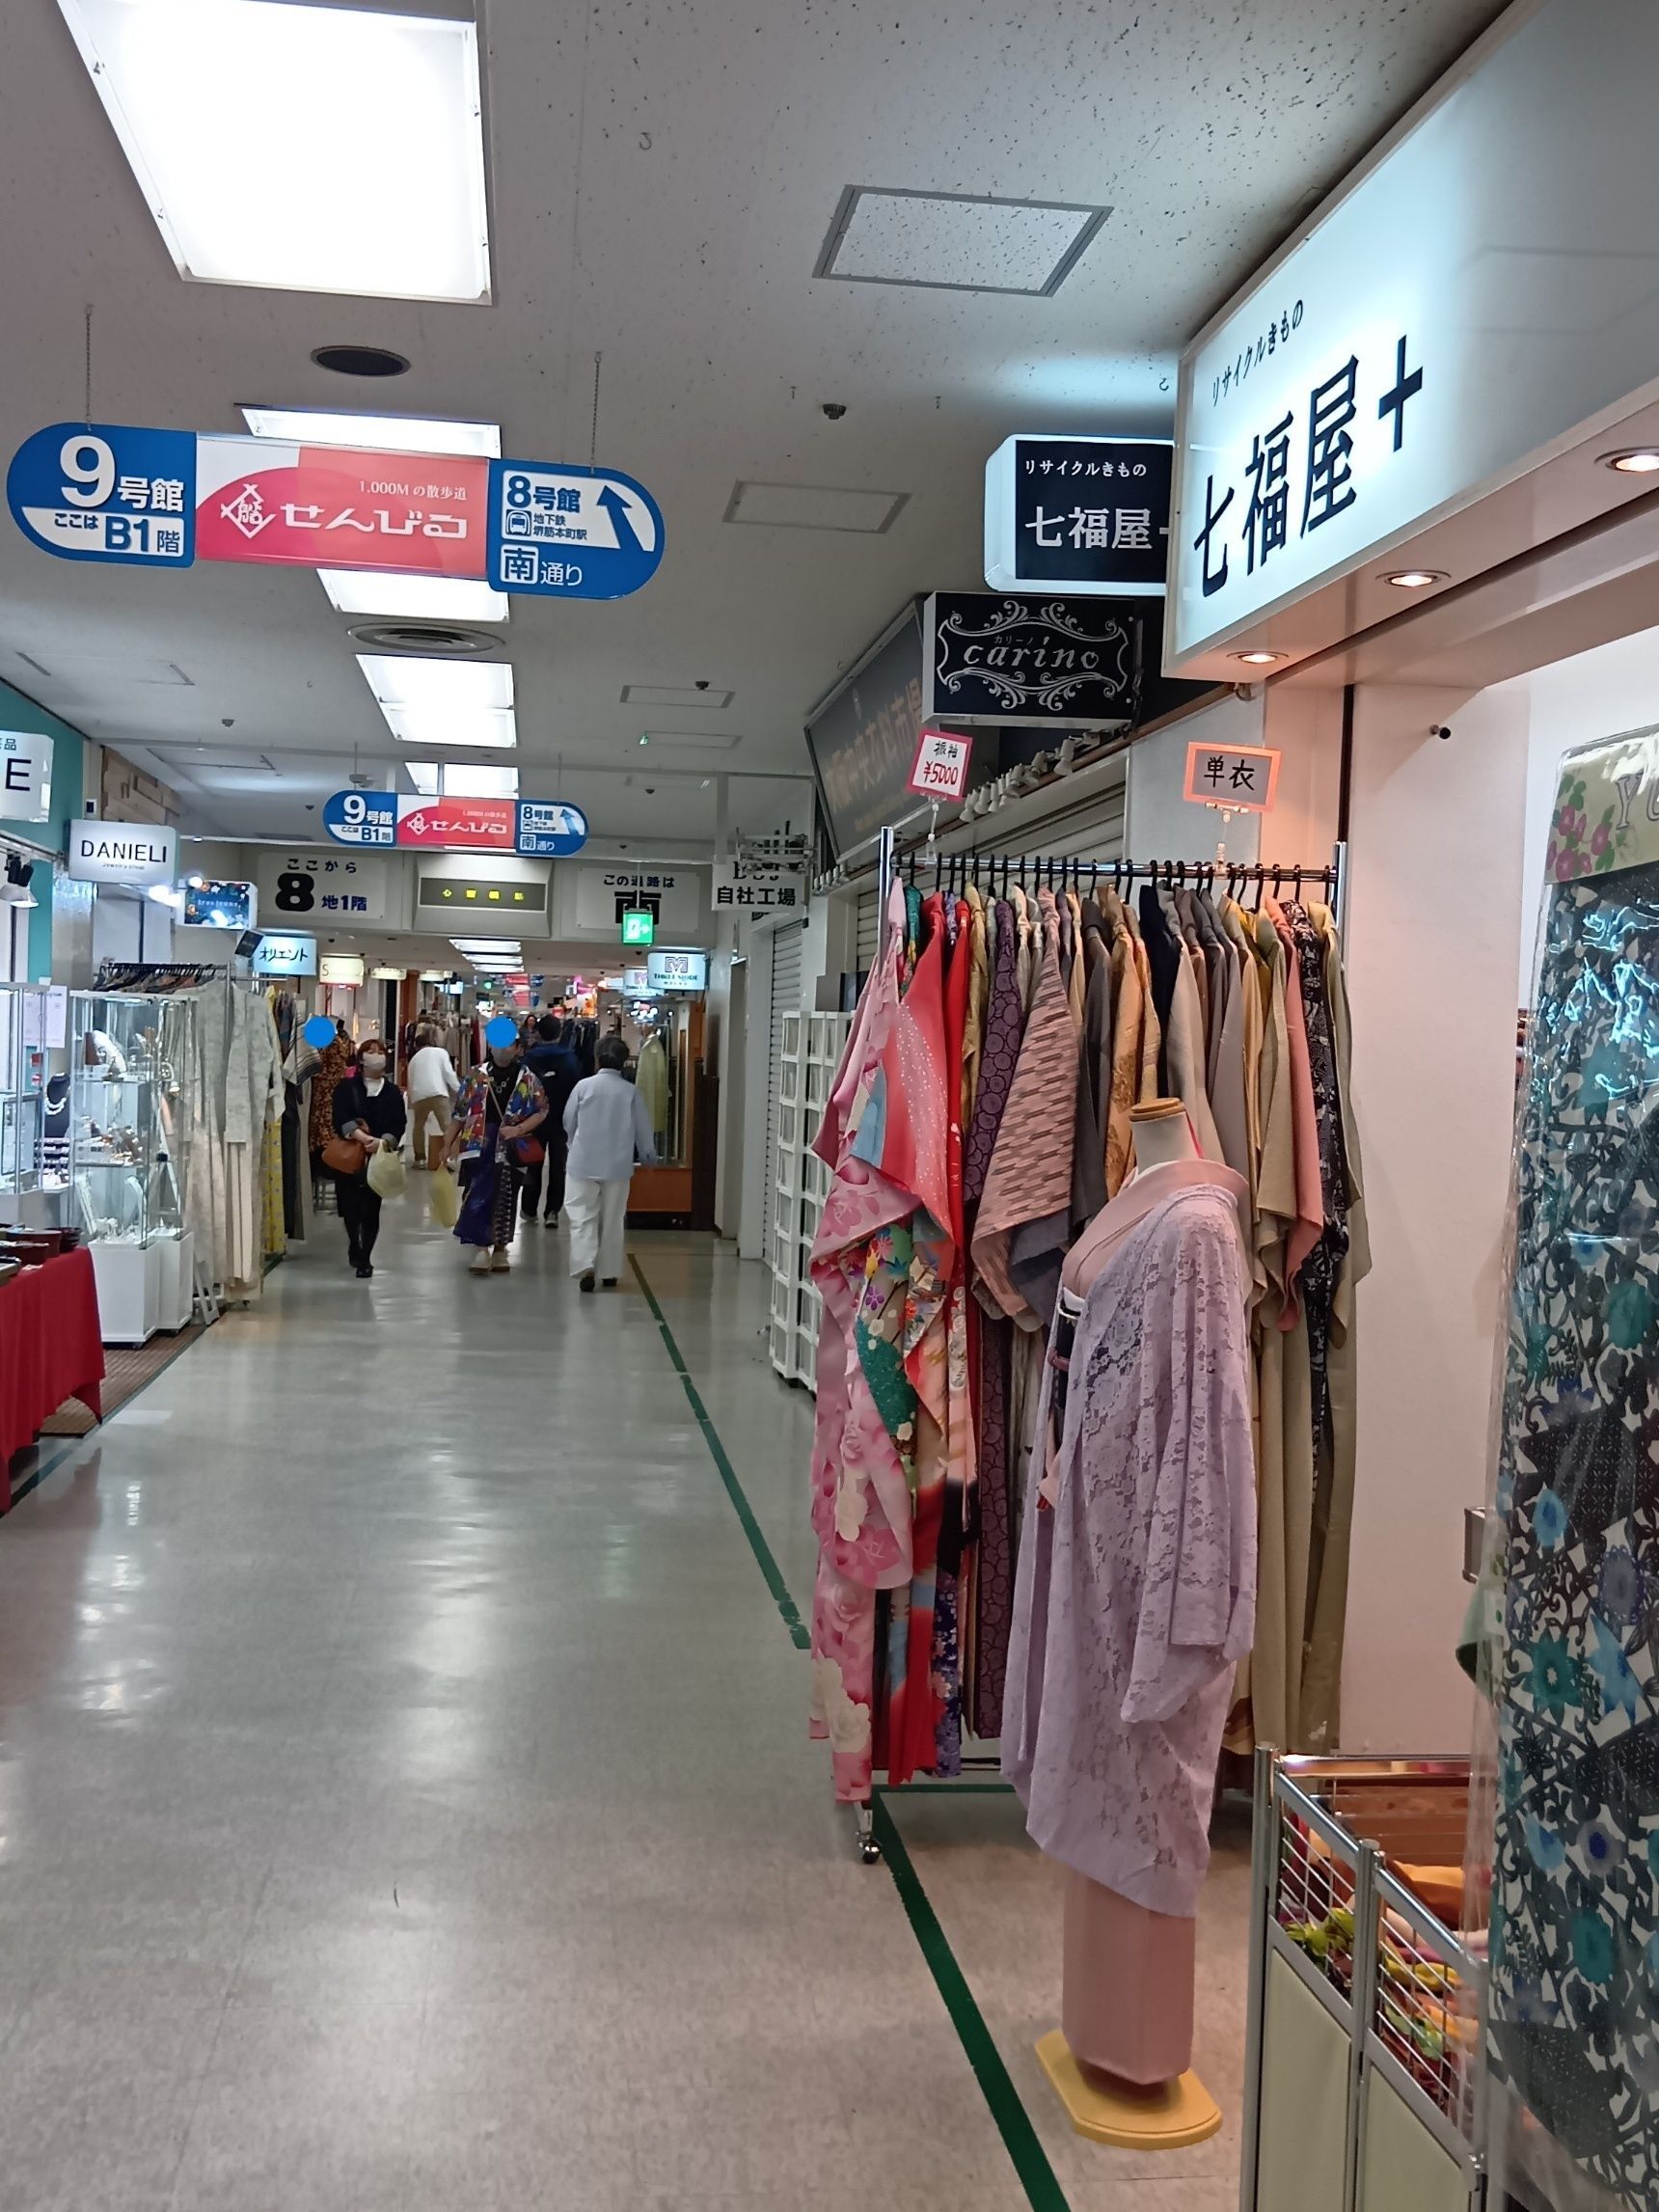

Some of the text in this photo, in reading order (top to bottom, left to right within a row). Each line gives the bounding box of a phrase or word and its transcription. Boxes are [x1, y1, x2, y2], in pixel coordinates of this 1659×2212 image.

[1212, 299, 1303, 407] リサイクルきもの
[59, 434, 184, 512] 9号館
[1024, 459, 1147, 478] リサイクルきもの
[413, 482, 468, 501] の散歩道
[506, 475, 582, 513] 8号館
[54, 512, 180, 554] ここは B1階
[280, 503, 468, 539] せんびる
[532, 512, 566, 527] 地下鉄
[532, 525, 587, 540] 堺筋本町駅
[1024, 505, 1171, 550] 七福屋
[503, 548, 583, 587] 南通り
[963, 635, 1100, 669] carino
[993, 634, 1034, 646] カリーノ
[5, 757, 32, 791] E
[923, 760, 959, 785] ¥5000
[1203, 755, 1255, 791] 単衣
[343, 794, 394, 825] 9号館
[81, 839, 167, 863] DANIELI
[286, 858, 358, 873] ここから
[321, 895, 367, 912] 地1階
[717, 886, 796, 906] 自社工場
[258, 946, 309, 963] オリエント
